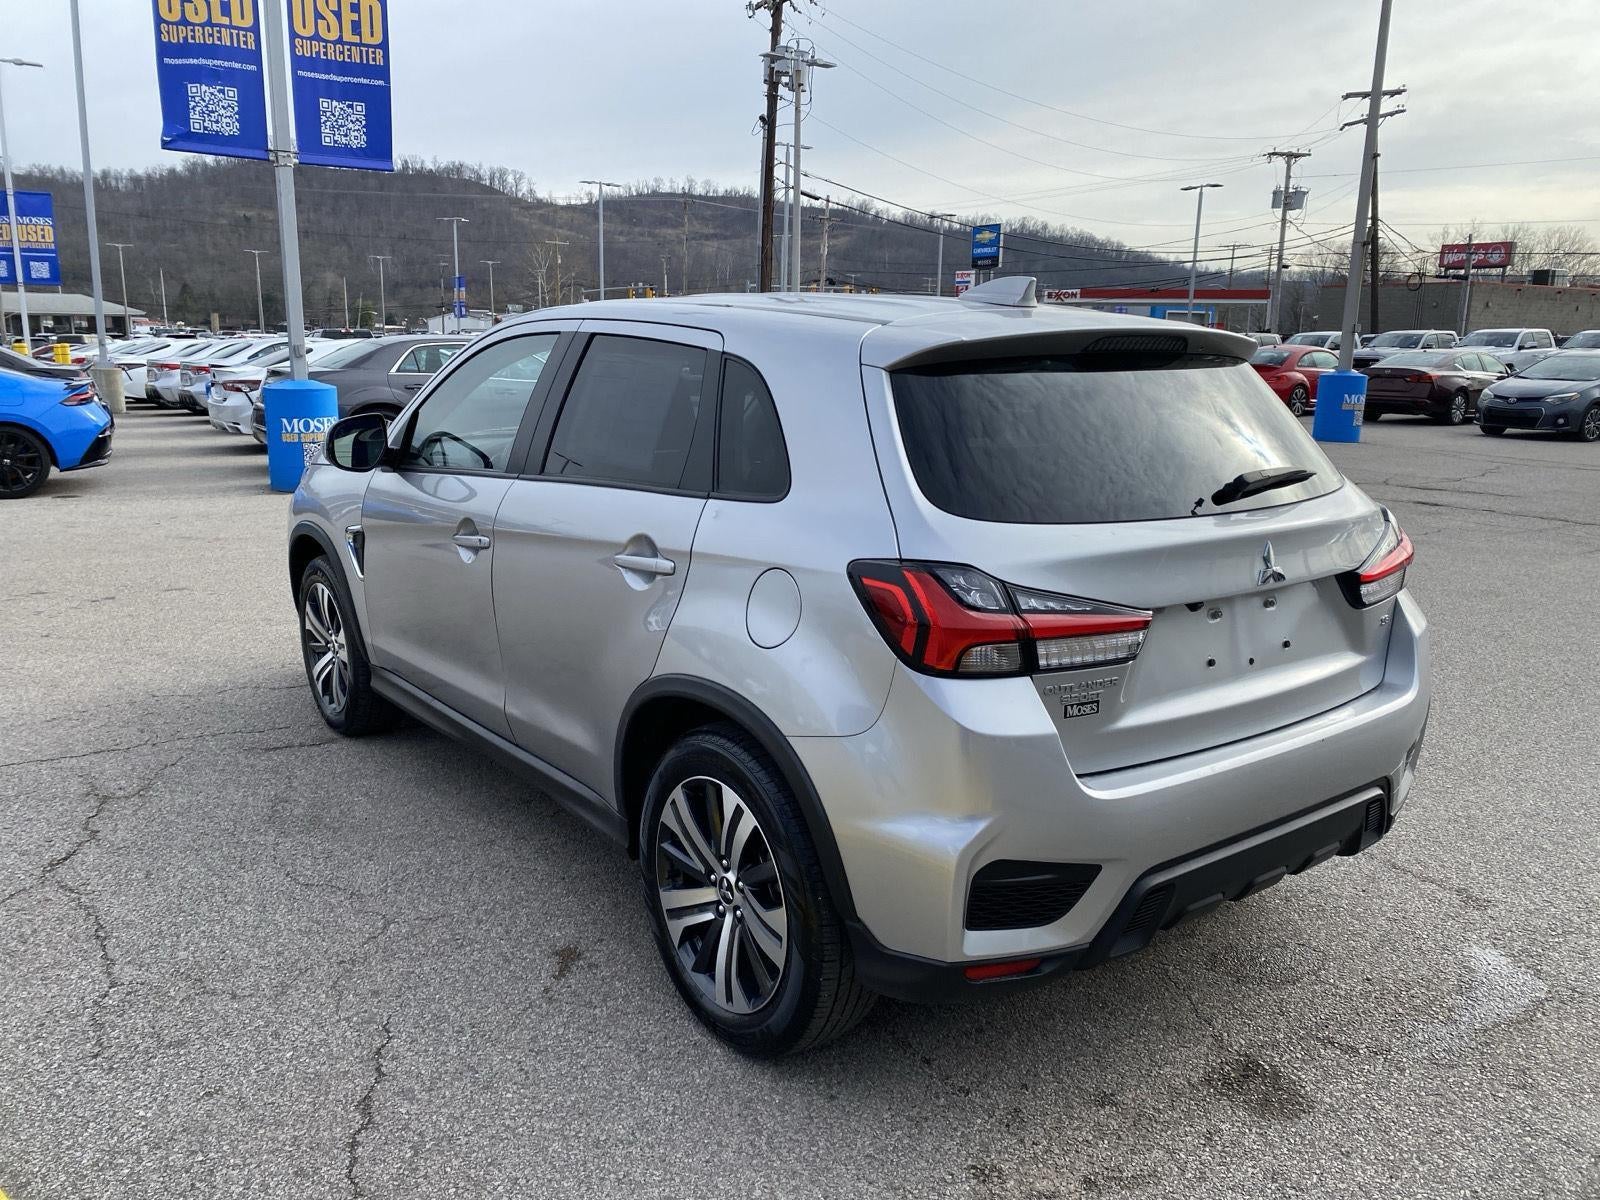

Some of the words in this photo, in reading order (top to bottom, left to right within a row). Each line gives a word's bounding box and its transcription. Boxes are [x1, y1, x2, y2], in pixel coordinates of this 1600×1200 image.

[292, 0, 383, 45] USED
[160, 23, 256, 50] SUPERCENTER
[294, 38, 384, 66] SUPERCENTER
[163, 57, 257, 71] mosesusedsupercenter.com
[297, 70, 385, 86] mosesusedsupercenter.com
[16, 216, 53, 225] MOSES
[17, 225, 54, 242] USED
[1443, 246, 1486, 265] Weny's
[1043, 676, 1119, 697] OUTLANDER
[1066, 703, 1098, 717] MOSES
